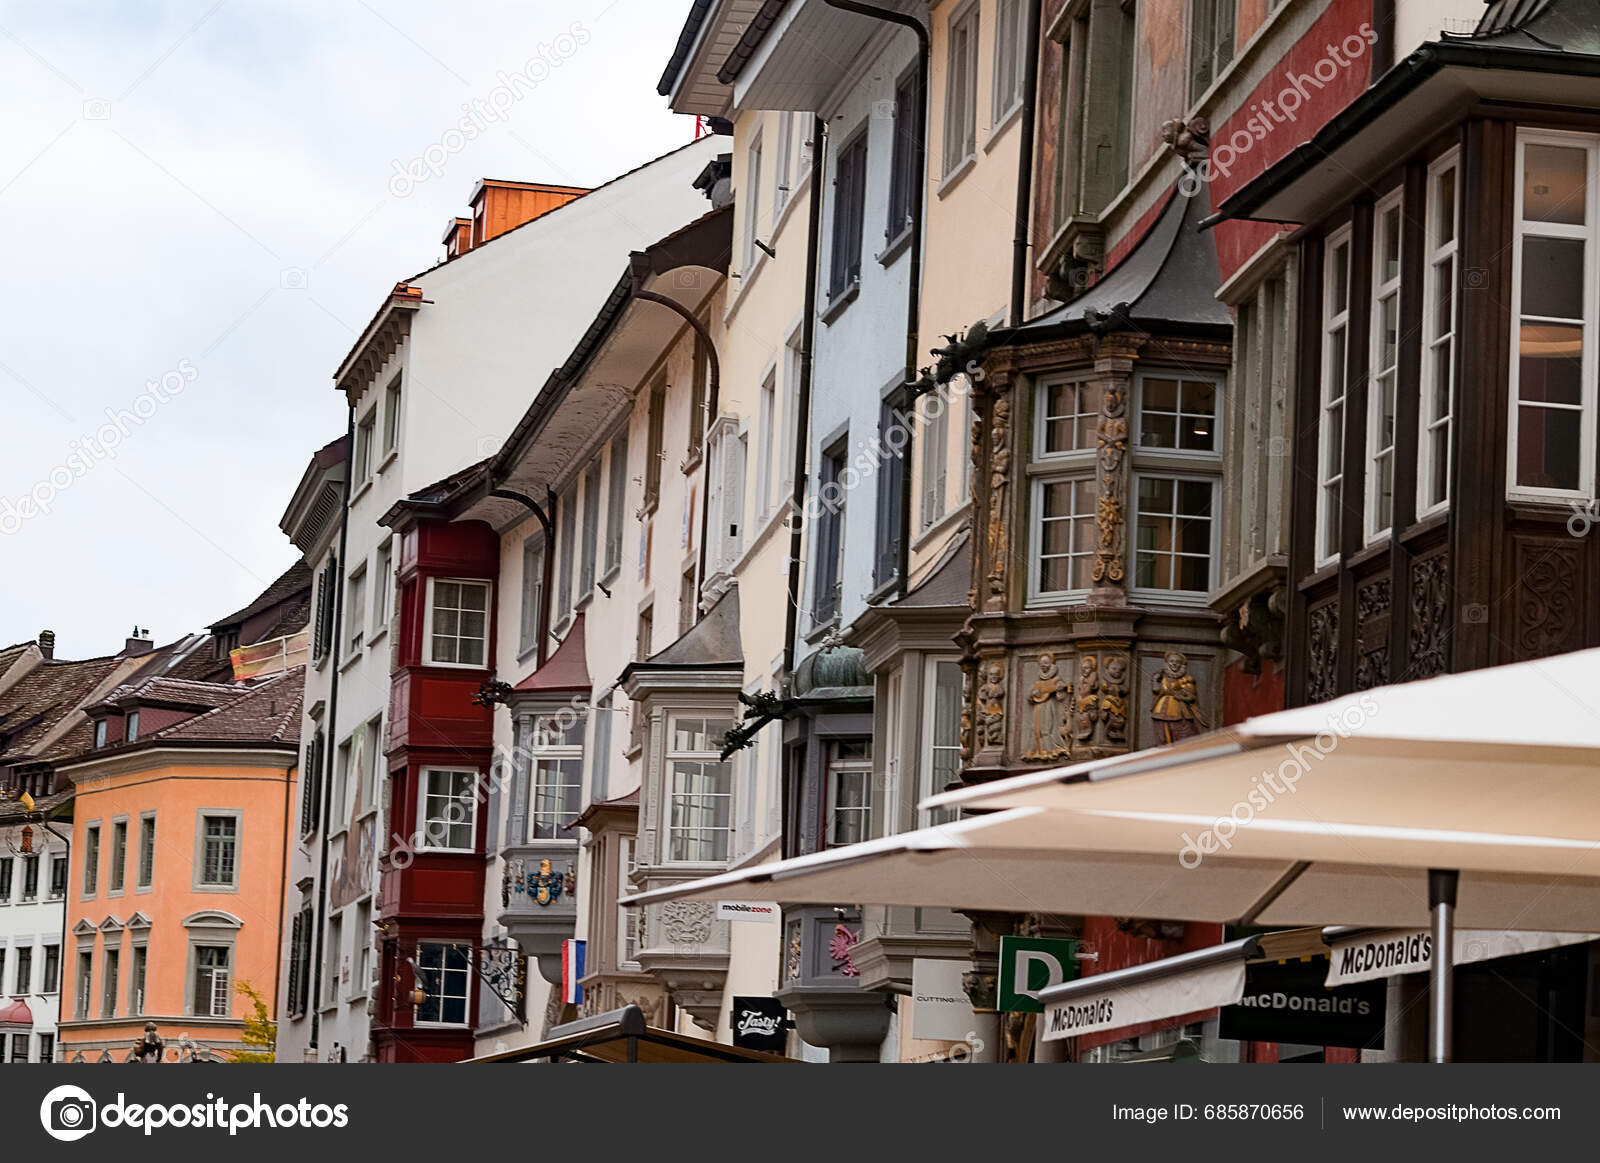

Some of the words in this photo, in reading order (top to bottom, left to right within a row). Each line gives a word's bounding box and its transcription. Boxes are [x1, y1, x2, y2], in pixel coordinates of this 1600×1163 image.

[722, 904, 772, 913] mobilezone
[1340, 933, 1432, 976] McDonald's
[917, 995, 954, 1003] CUTTING
[737, 1010, 781, 1030] Tasty!
[1051, 998, 1113, 1032] McDonald's
